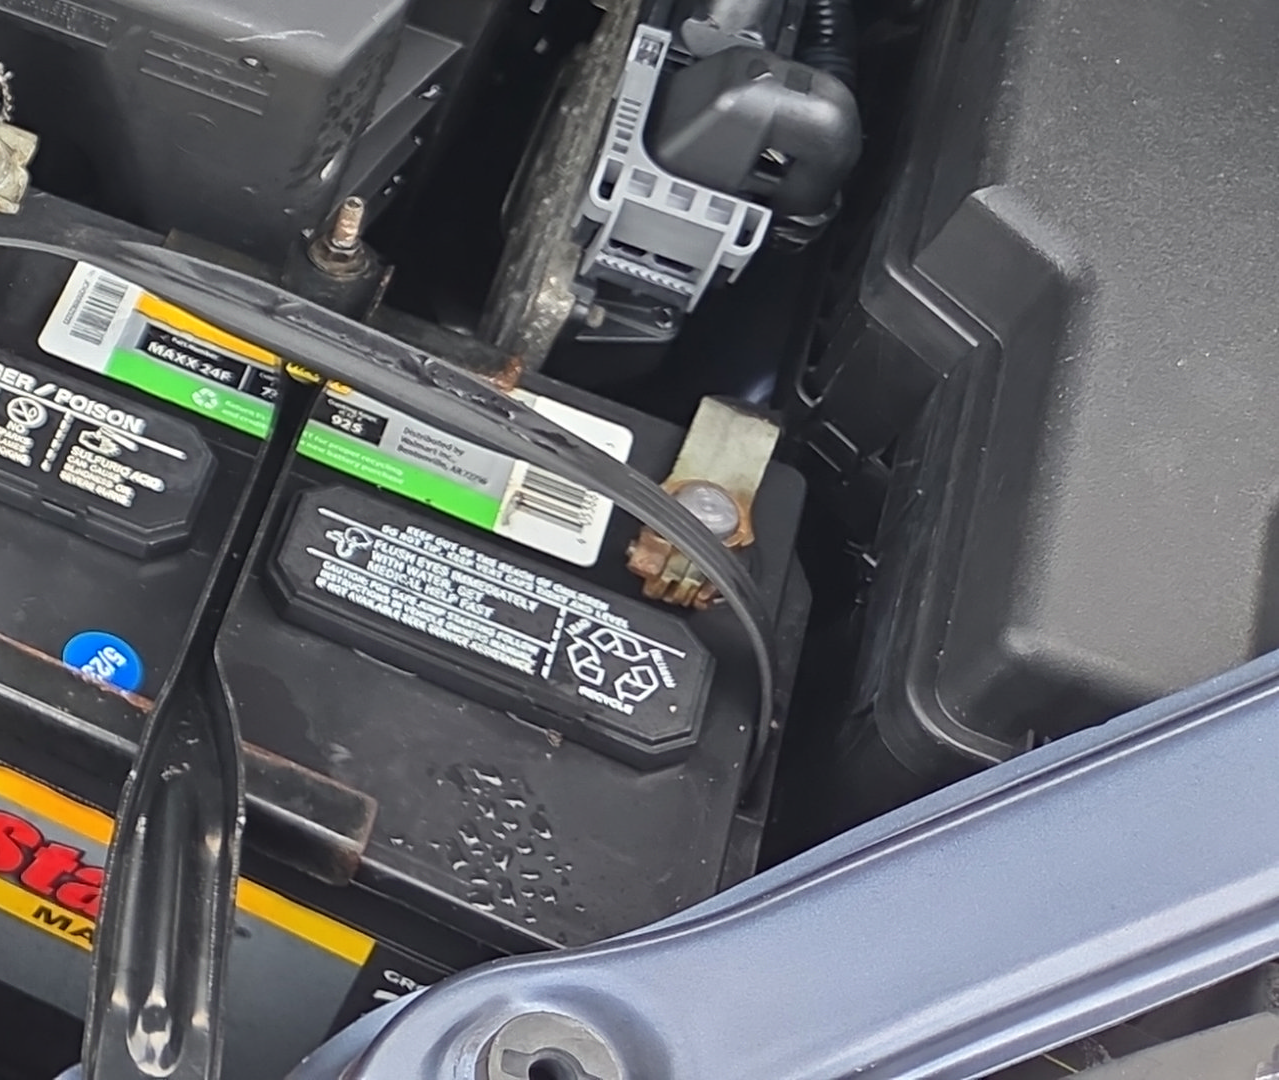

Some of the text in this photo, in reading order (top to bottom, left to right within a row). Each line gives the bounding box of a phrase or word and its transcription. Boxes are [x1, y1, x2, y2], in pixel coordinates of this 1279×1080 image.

[147, 340, 199, 370] MAXX
[6, 419, 29, 436] NO
[53, 389, 147, 434] POISON
[328, 413, 364, 435] 925
[71, 445, 132, 479] SULFURIC
[399, 532, 422, 547] NOT
[319, 569, 392, 605] INSTRUCTIONS
[365, 560, 496, 619] MEDICAL HELP FAST
[369, 580, 392, 596] FOR
[370, 550, 406, 572] WITH
[457, 585, 485, 604] GET
[373, 539, 540, 614] FLUSH EYES IMMEDIATELY
[578, 685, 635, 716] RECYCLE
